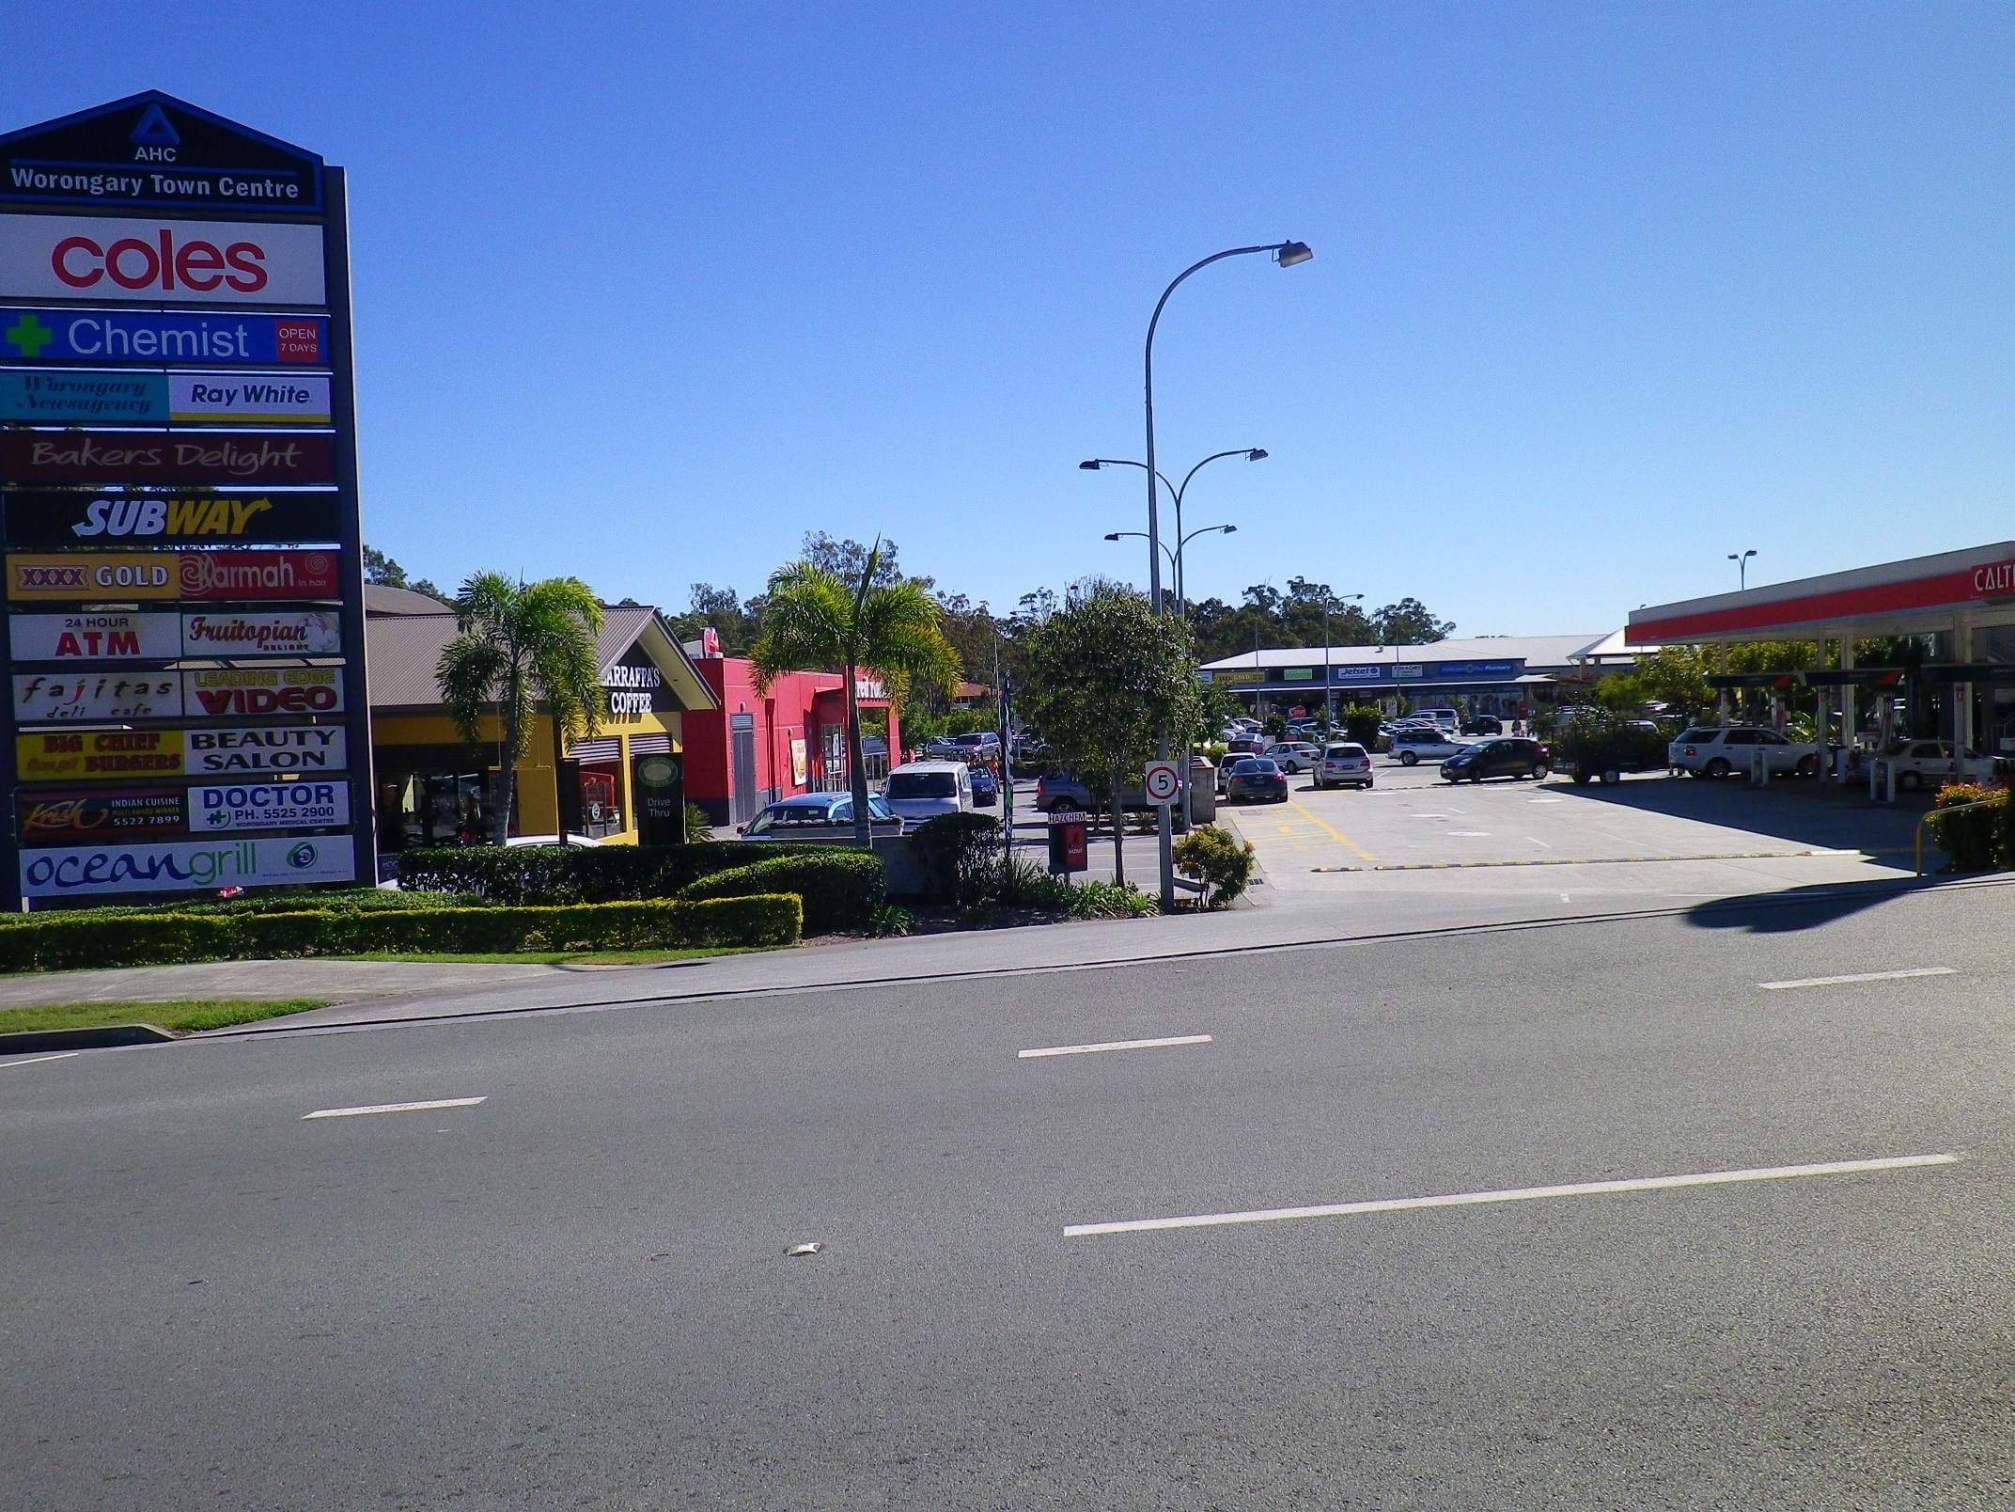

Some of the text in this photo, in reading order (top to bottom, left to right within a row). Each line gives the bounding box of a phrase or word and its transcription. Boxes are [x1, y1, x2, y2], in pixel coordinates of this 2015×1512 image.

[135, 147, 176, 162] AHC
[11, 168, 299, 198] Worongary Town Centre
[52, 229, 268, 292] coles
[68, 319, 249, 358] Chemist
[279, 328, 316, 340] OPEN
[281, 343, 317, 353] 7 DAYS
[191, 385, 310, 409] Ray White
[31, 438, 303, 475] Bakers Delight
[72, 498, 272, 538] SUBWAY
[23, 565, 169, 587] XXXX GOLD
[1974, 564, 2015, 591] CALT
[64, 617, 129, 628] 24 HOUR
[190, 616, 308, 648] Fruitopian
[55, 631, 141, 657] ATM
[194, 671, 278, 687] LEADING
[23, 677, 173, 705] fajitas
[195, 686, 337, 715] VIDEO
[47, 703, 153, 718] deli cafe
[611, 692, 652, 714] COFFEE
[44, 735, 83, 753] BIG
[191, 730, 336, 750] BEAUTY
[84, 753, 181, 772] BURGERS
[203, 751, 326, 771] SALON
[1158, 775, 1168, 790] 5
[111, 797, 181, 808] INDIAN CUISINE
[203, 784, 334, 809] DOCTOR
[648, 798, 672, 807] Drive
[114, 817, 144, 826] 5522
[235, 806, 334, 820] PH. 5525 2900
[648, 808, 670, 817] Thru
